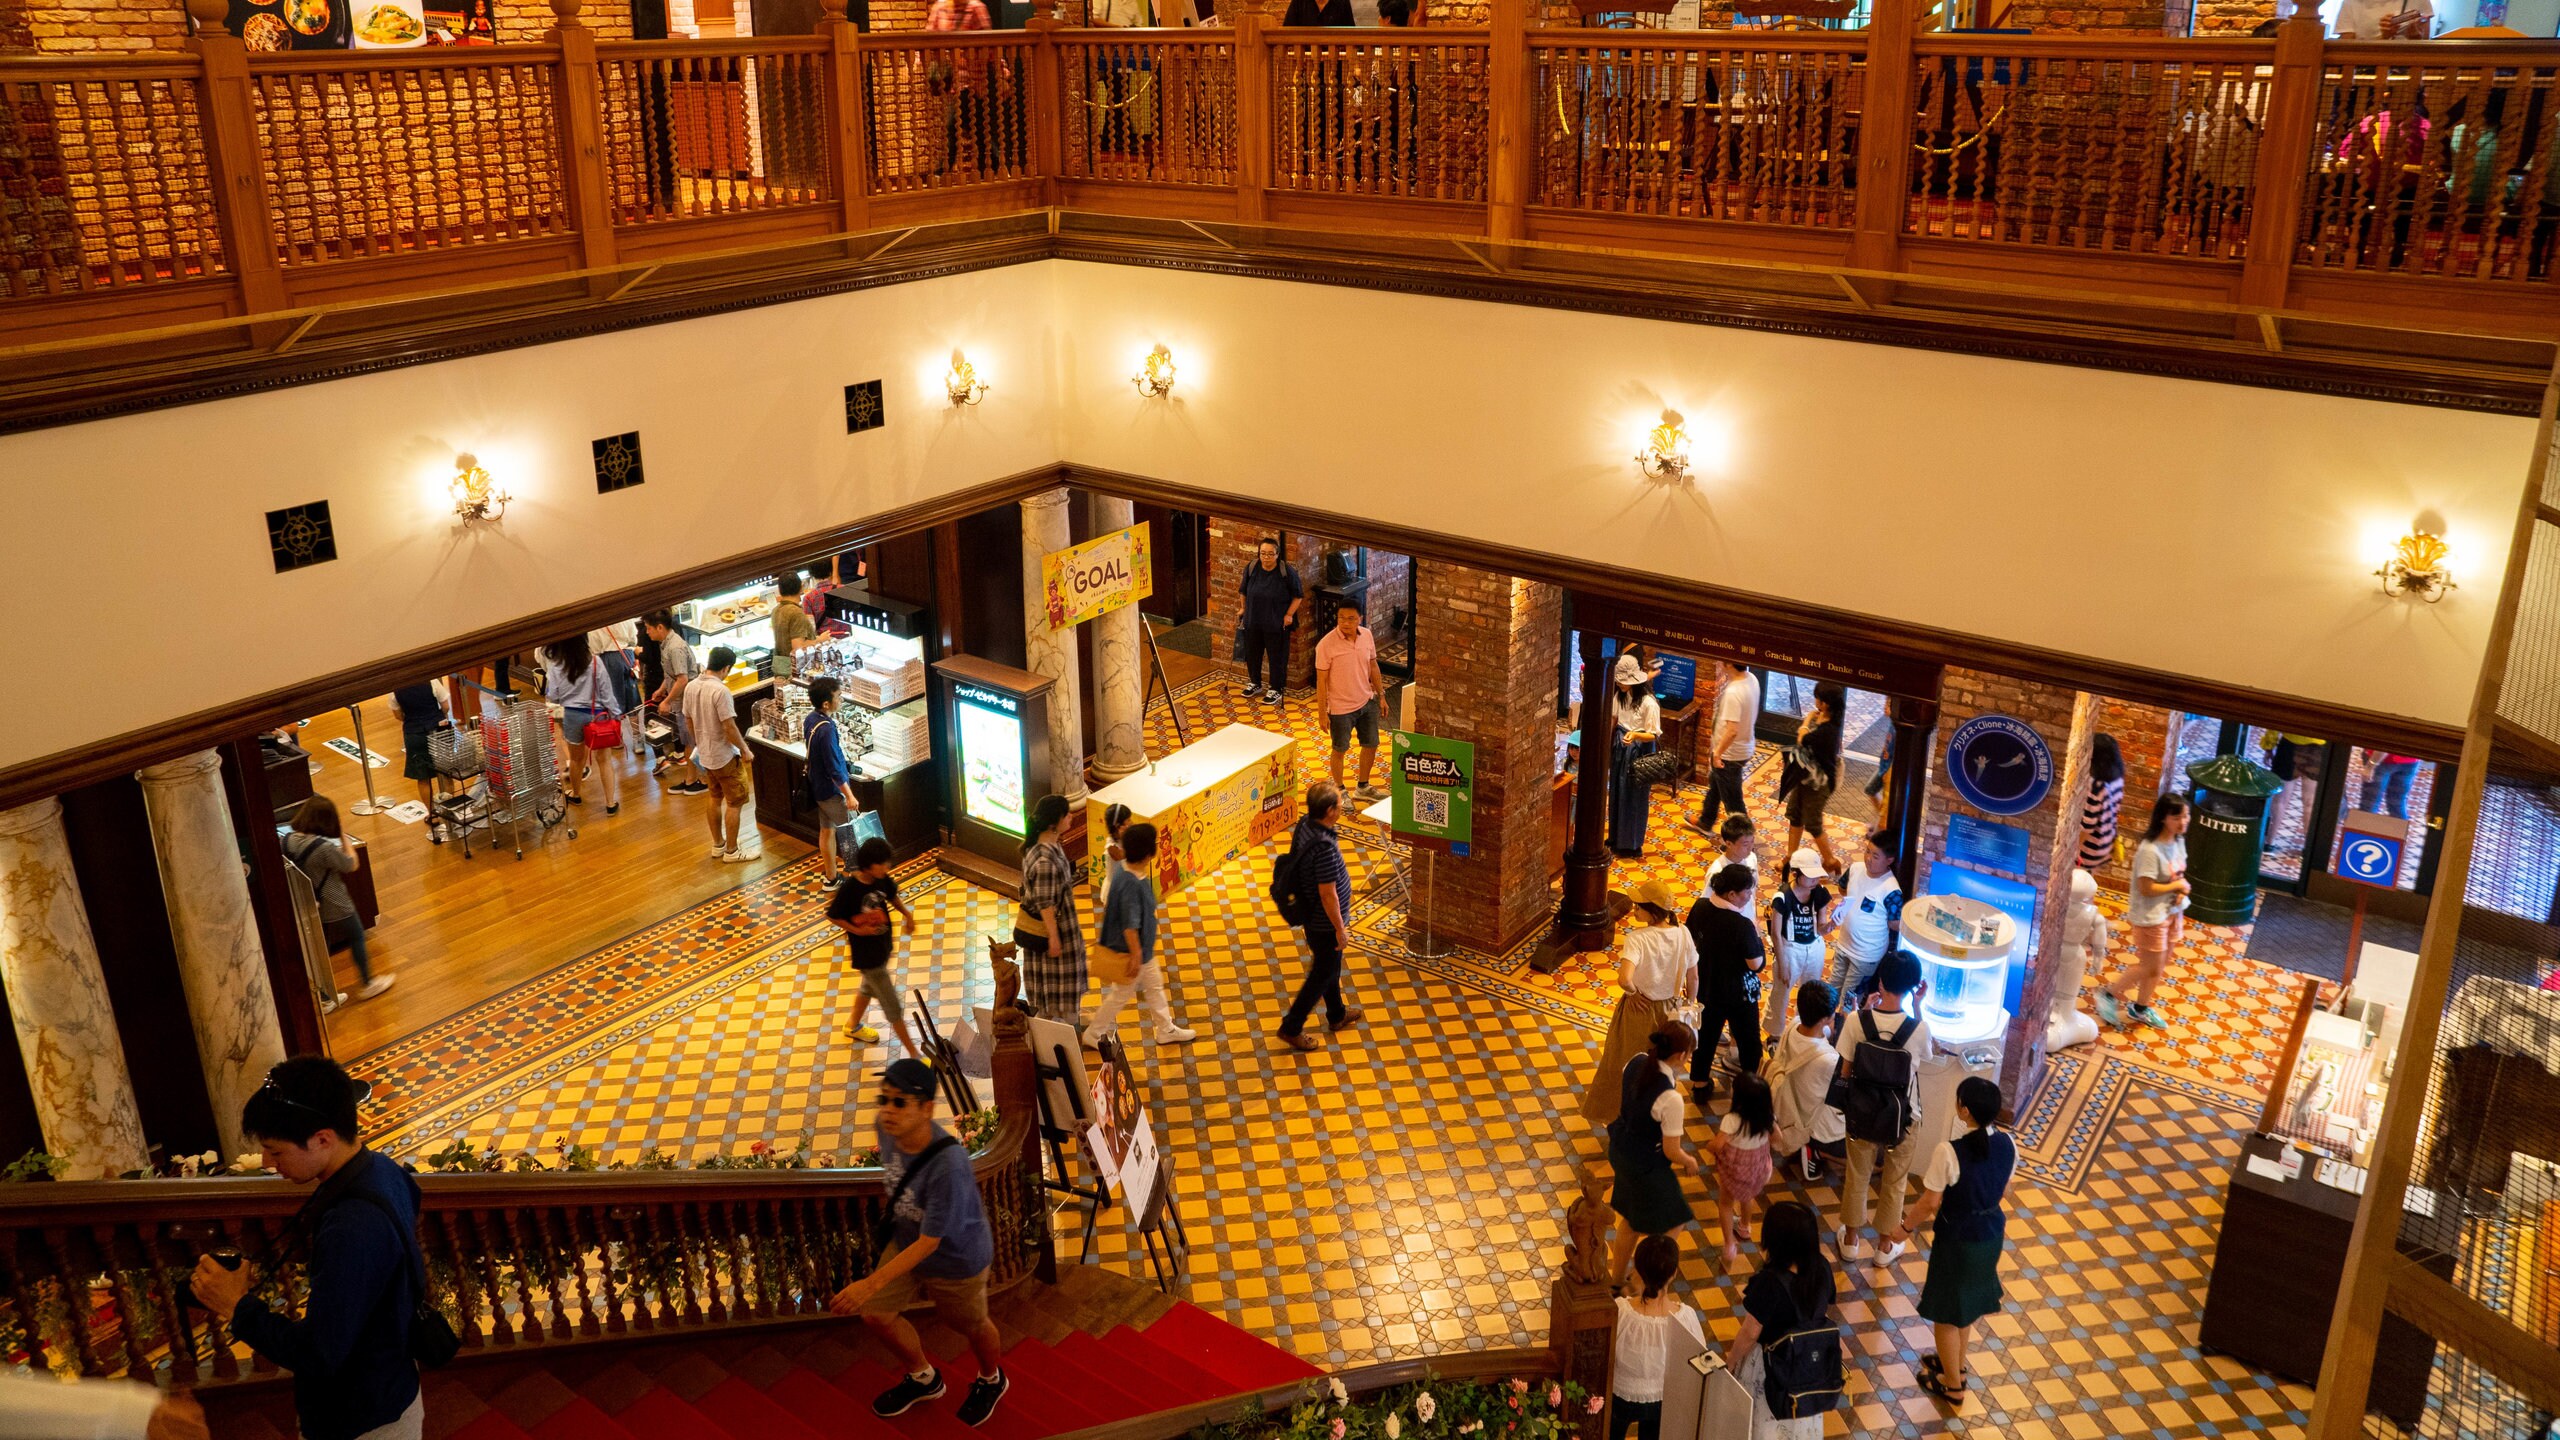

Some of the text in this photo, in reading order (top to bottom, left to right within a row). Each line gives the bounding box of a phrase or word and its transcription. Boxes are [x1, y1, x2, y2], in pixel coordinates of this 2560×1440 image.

[1074, 558, 1128, 593] GOAL
[841, 609, 889, 633] ISHIYA
[1620, 621, 1643, 632] Thank
[1644, 626, 1658, 635] you
[1765, 650, 1793, 662] Gracias
[1800, 657, 1821, 669] Merci
[1827, 662, 1853, 675] Danke
[1858, 669, 1884, 681] Grazie
[1405, 756, 1461, 777] 白色恋人
[2200, 815, 2247, 834] LITTER
